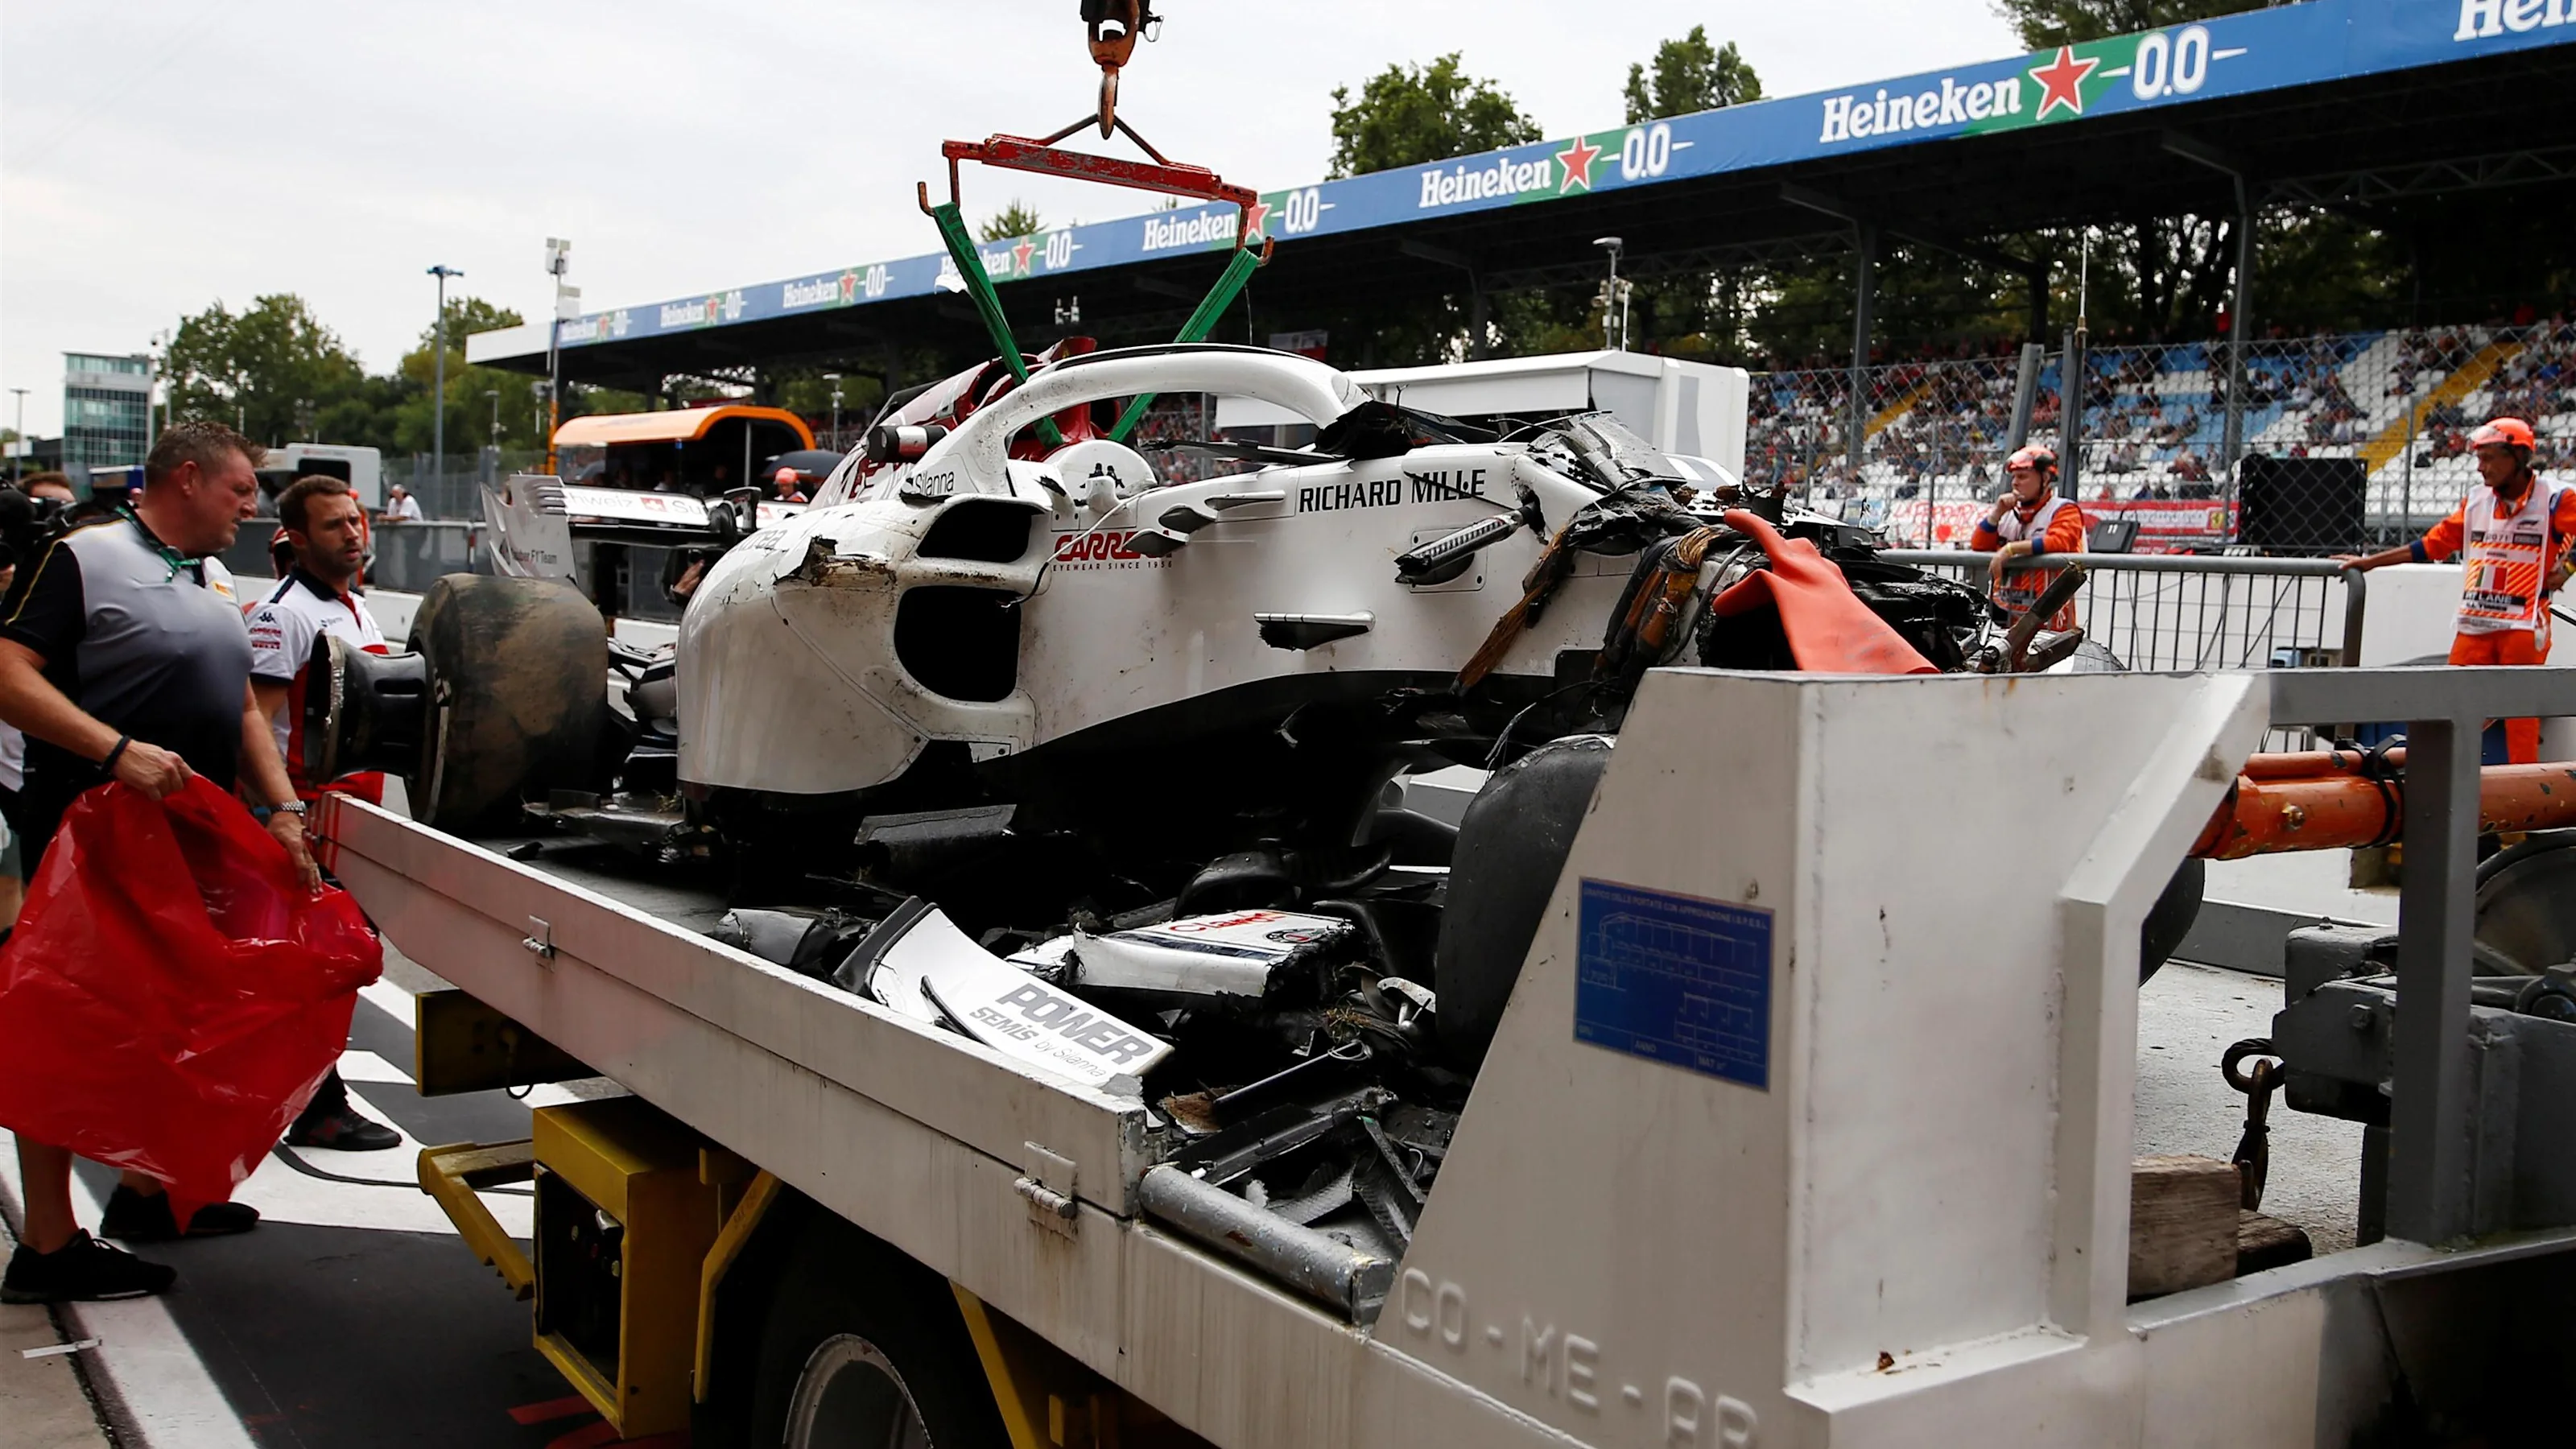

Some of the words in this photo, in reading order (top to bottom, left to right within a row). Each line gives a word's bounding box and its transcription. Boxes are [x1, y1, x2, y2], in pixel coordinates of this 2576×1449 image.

[1819, 76, 2022, 143] Heineken
[2133, 24, 2210, 101] 0.0
[1418, 158, 1552, 208] Heineken
[1621, 122, 1671, 181] 0.0
[1142, 210, 1236, 251] Heineken
[1285, 188, 1319, 233] 0.0
[941, 250, 1010, 276] Heken
[1046, 231, 1071, 270] 0.0
[782, 279, 838, 308] Heineken
[914, 471, 955, 496] Silanna
[1298, 479, 1402, 513] RICHARD
[1411, 469, 1486, 504] MILLE
[1053, 563, 1101, 572] EYEWEAR
[1148, 560, 1173, 568] 1956
[2479, 592, 2512, 604] LANE
[995, 983, 1154, 1065] POWER
[1034, 1038, 1053, 1052] by
[1053, 1048, 1108, 1078] Silanna
